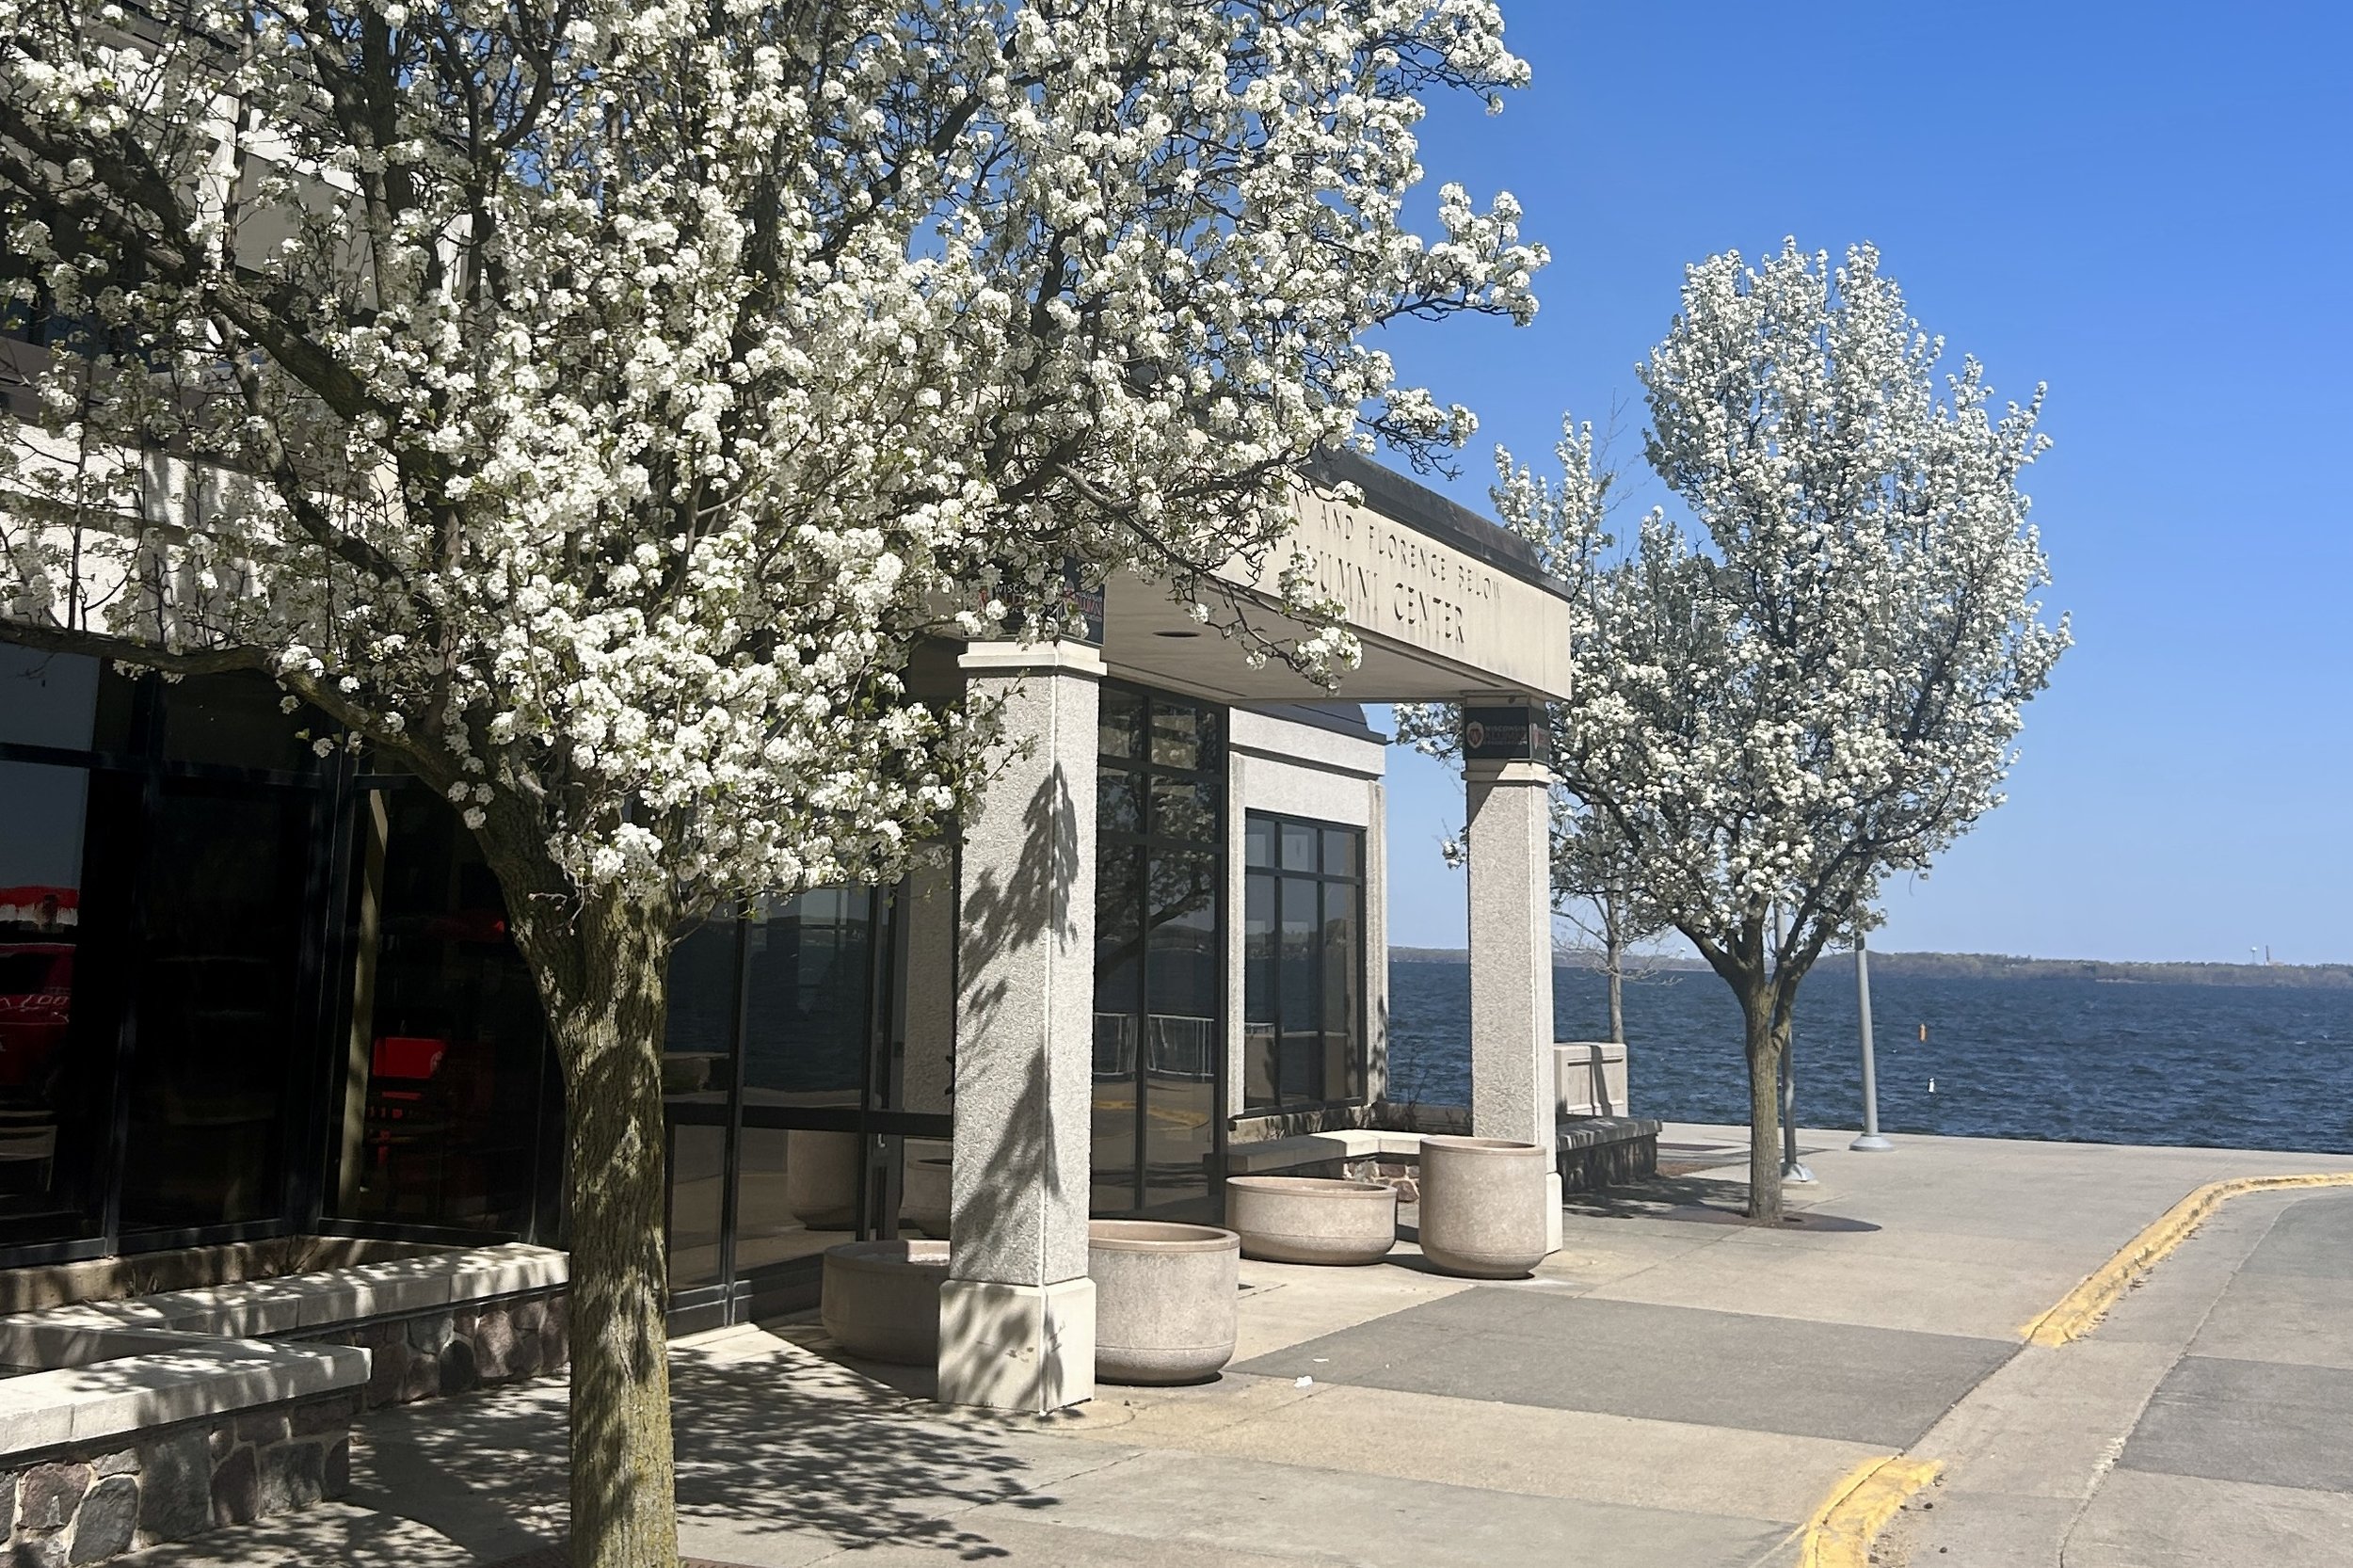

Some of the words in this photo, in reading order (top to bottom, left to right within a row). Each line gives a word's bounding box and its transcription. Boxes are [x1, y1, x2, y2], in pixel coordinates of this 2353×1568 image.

[1291, 539, 1378, 612] UMNI
[1393, 582, 1465, 644] CENTER
[1320, 504, 1353, 540] AND
[1369, 524, 1446, 582] FLORENCE
[1458, 565, 1504, 600] BELOW
